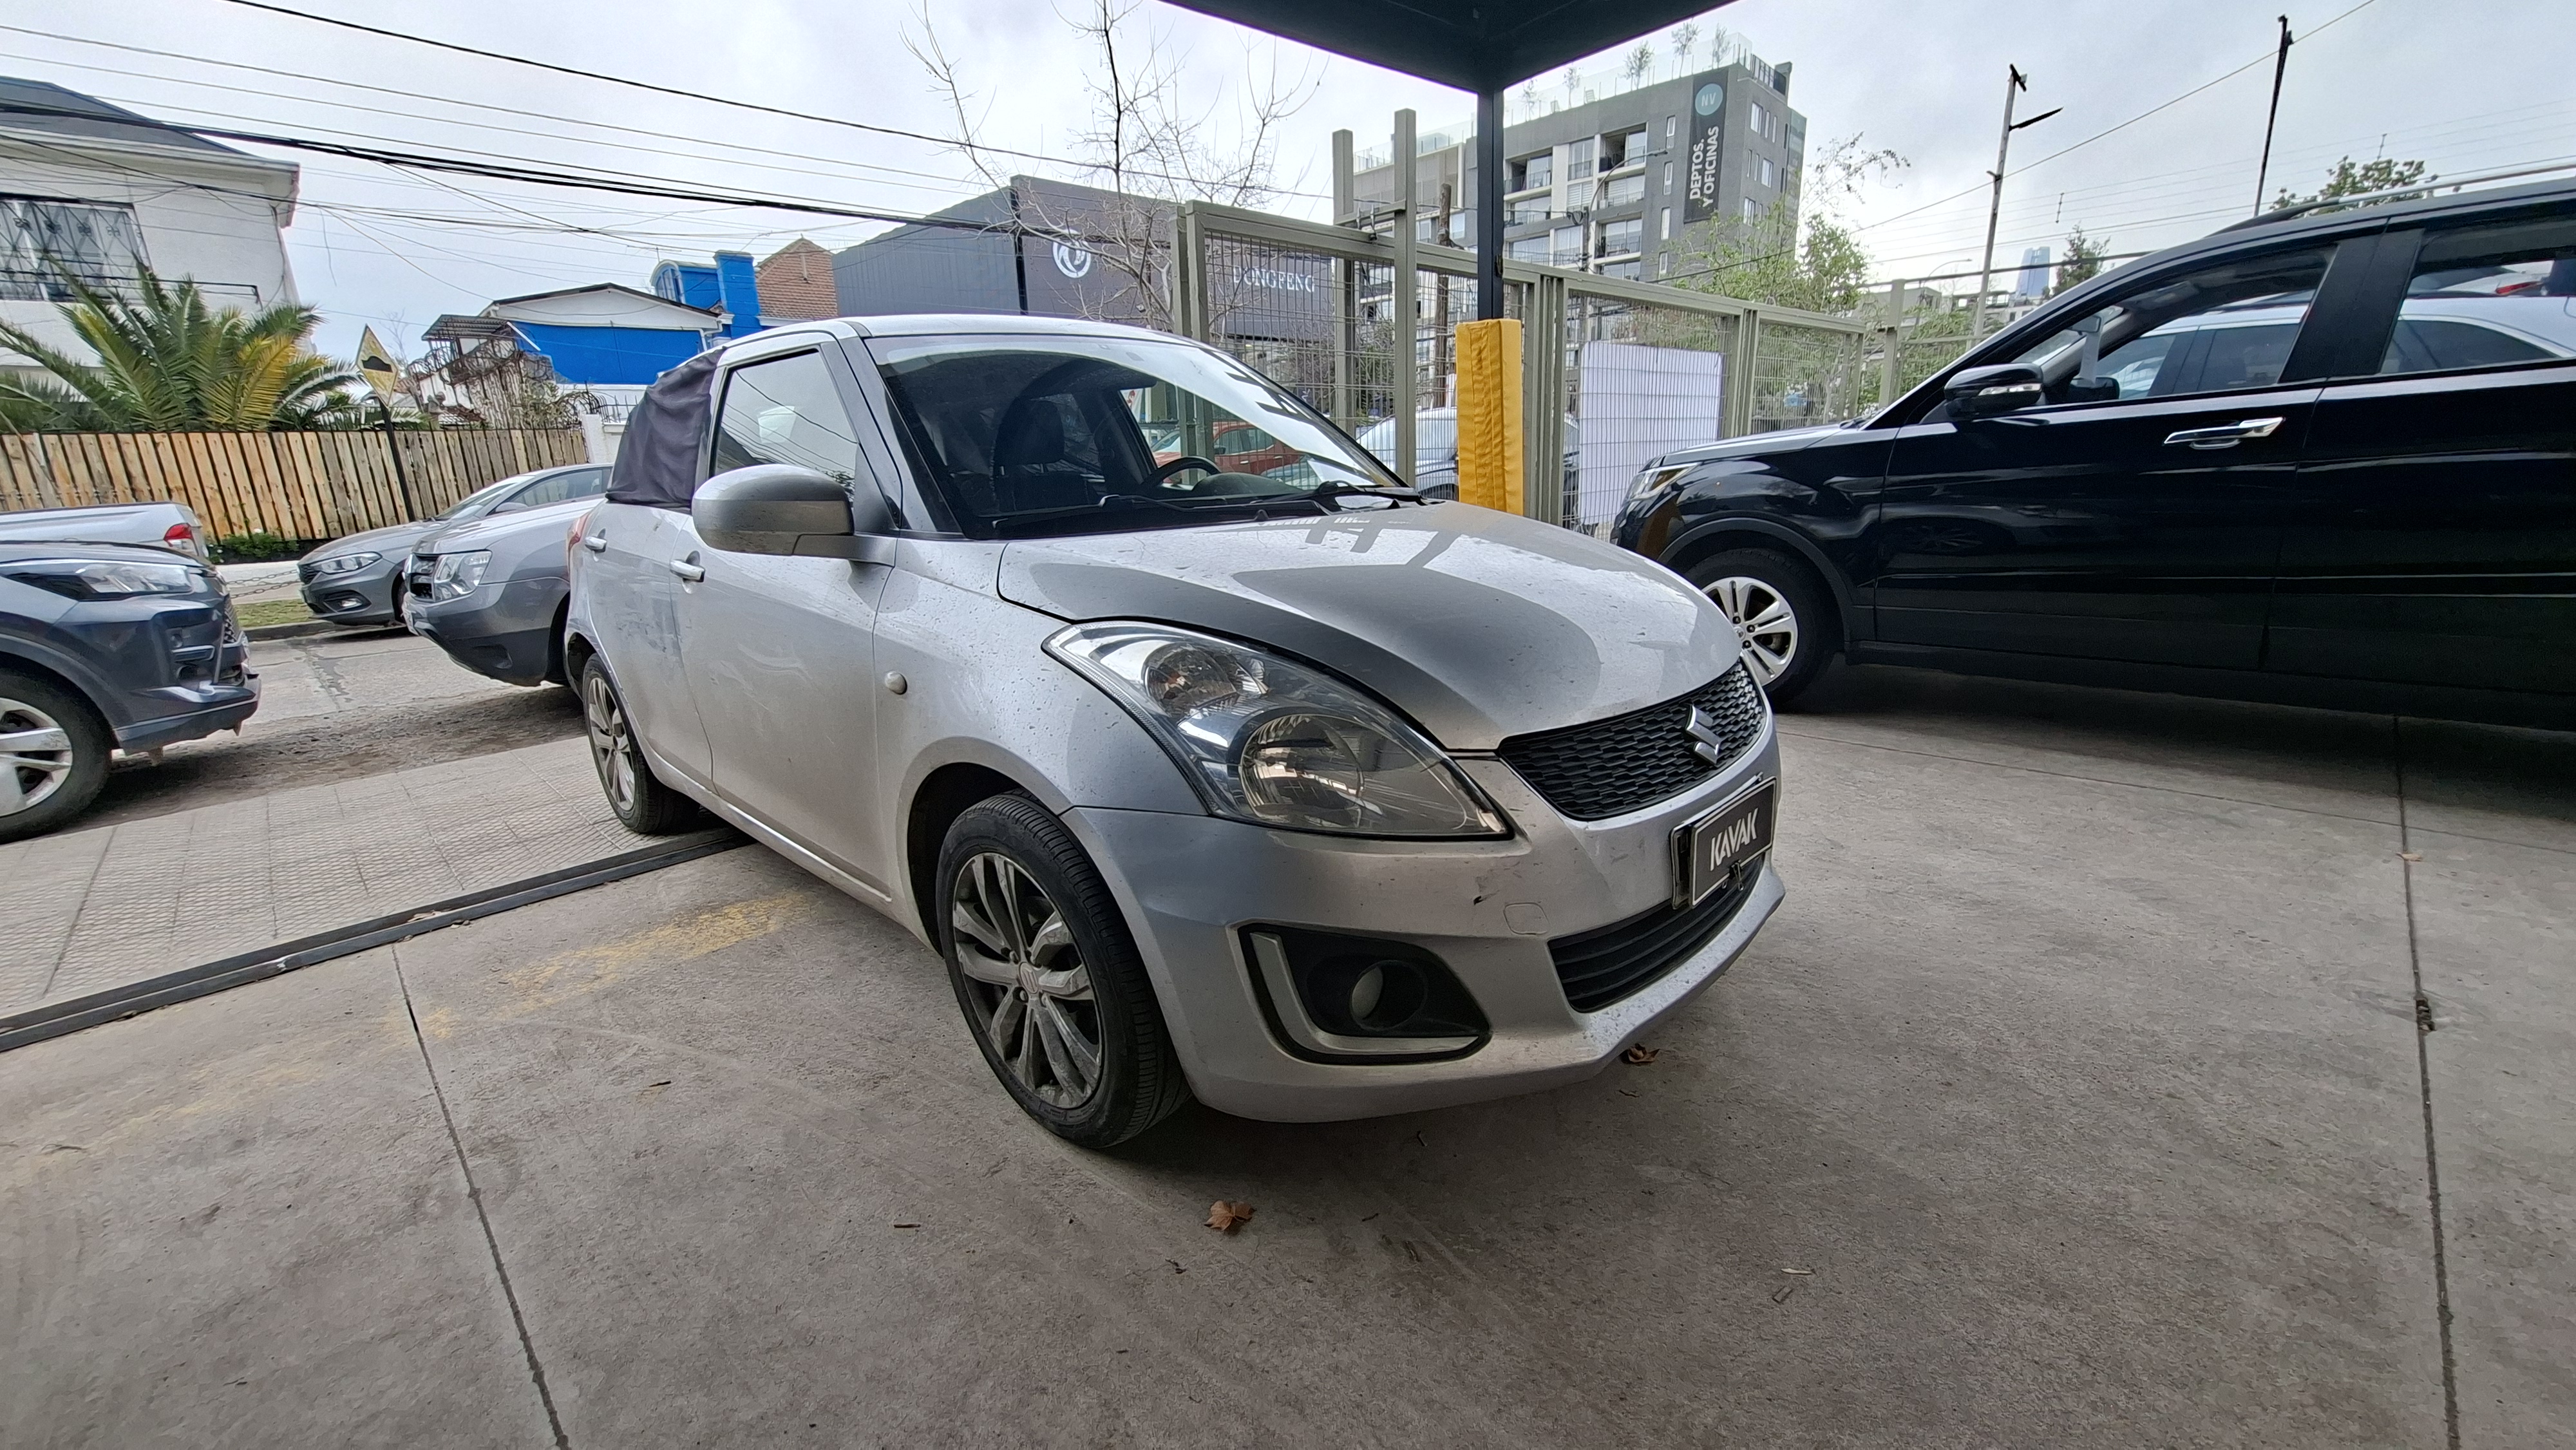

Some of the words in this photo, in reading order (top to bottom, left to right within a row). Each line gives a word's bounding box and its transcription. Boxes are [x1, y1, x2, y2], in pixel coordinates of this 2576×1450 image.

[1701, 93, 1716, 106] NV
[1690, 138, 1704, 200] DEPTOS.
[1703, 126, 1719, 194] OFICINAS
[1703, 194, 1714, 208] Y
[1710, 807, 1759, 872] KAVAK
